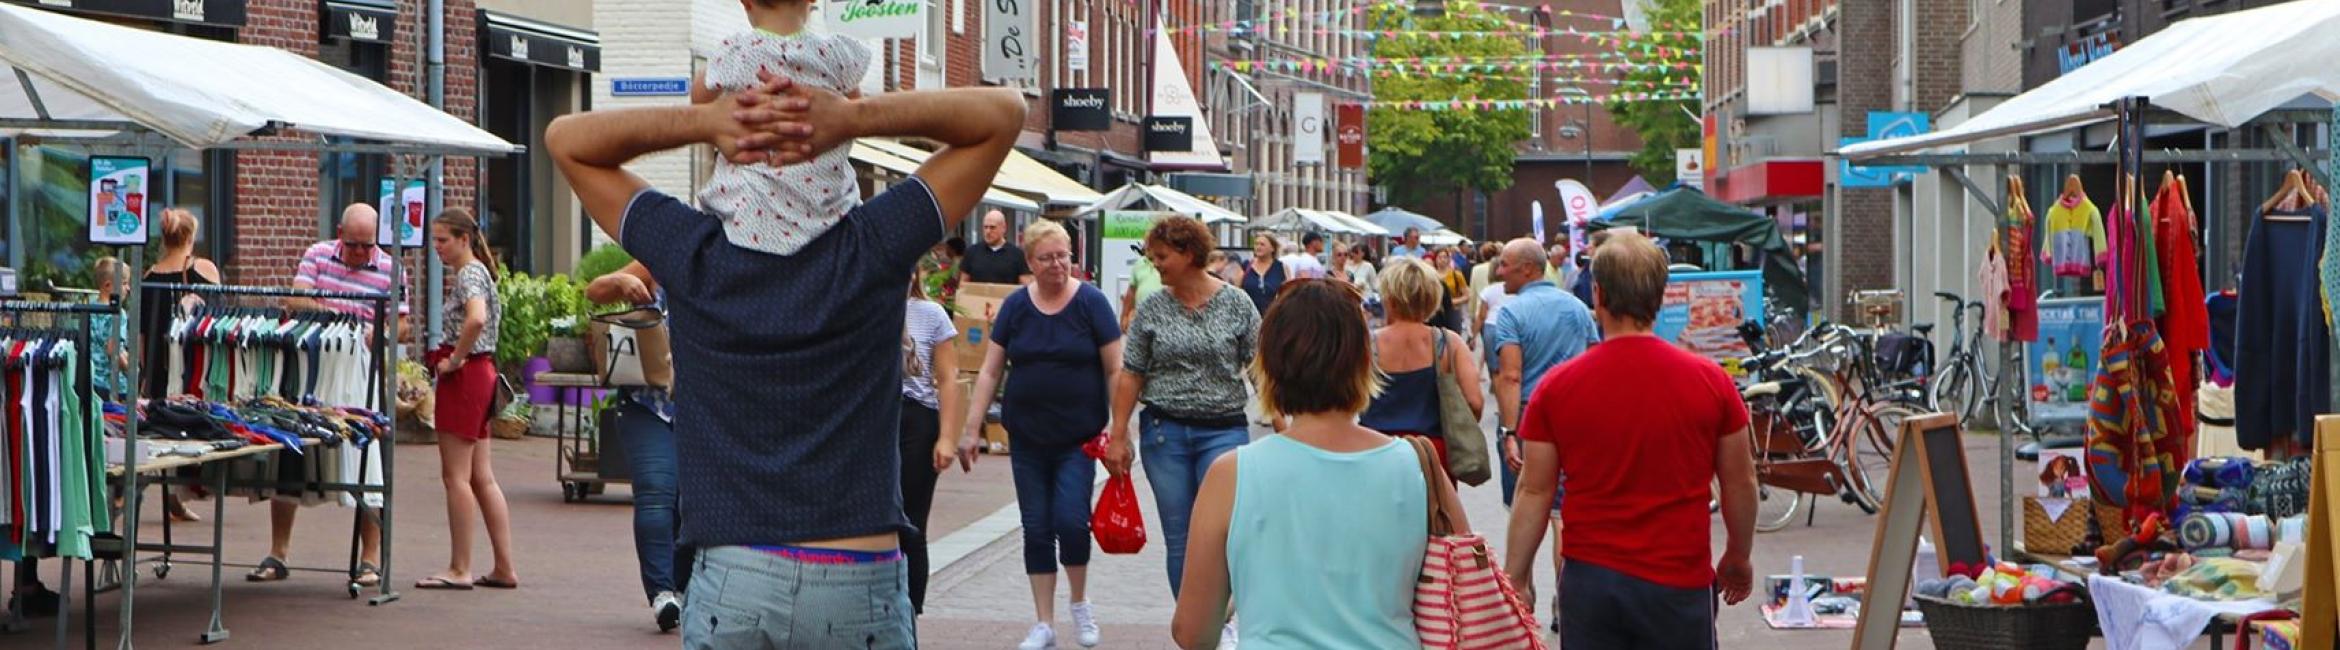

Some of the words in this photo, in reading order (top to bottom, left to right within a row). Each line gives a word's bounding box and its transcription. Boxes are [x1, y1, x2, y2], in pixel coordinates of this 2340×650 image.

[840, 0, 918, 21] Joosten
[1063, 93, 1105, 110] shoeby
[1151, 120, 1186, 135] shoeby
